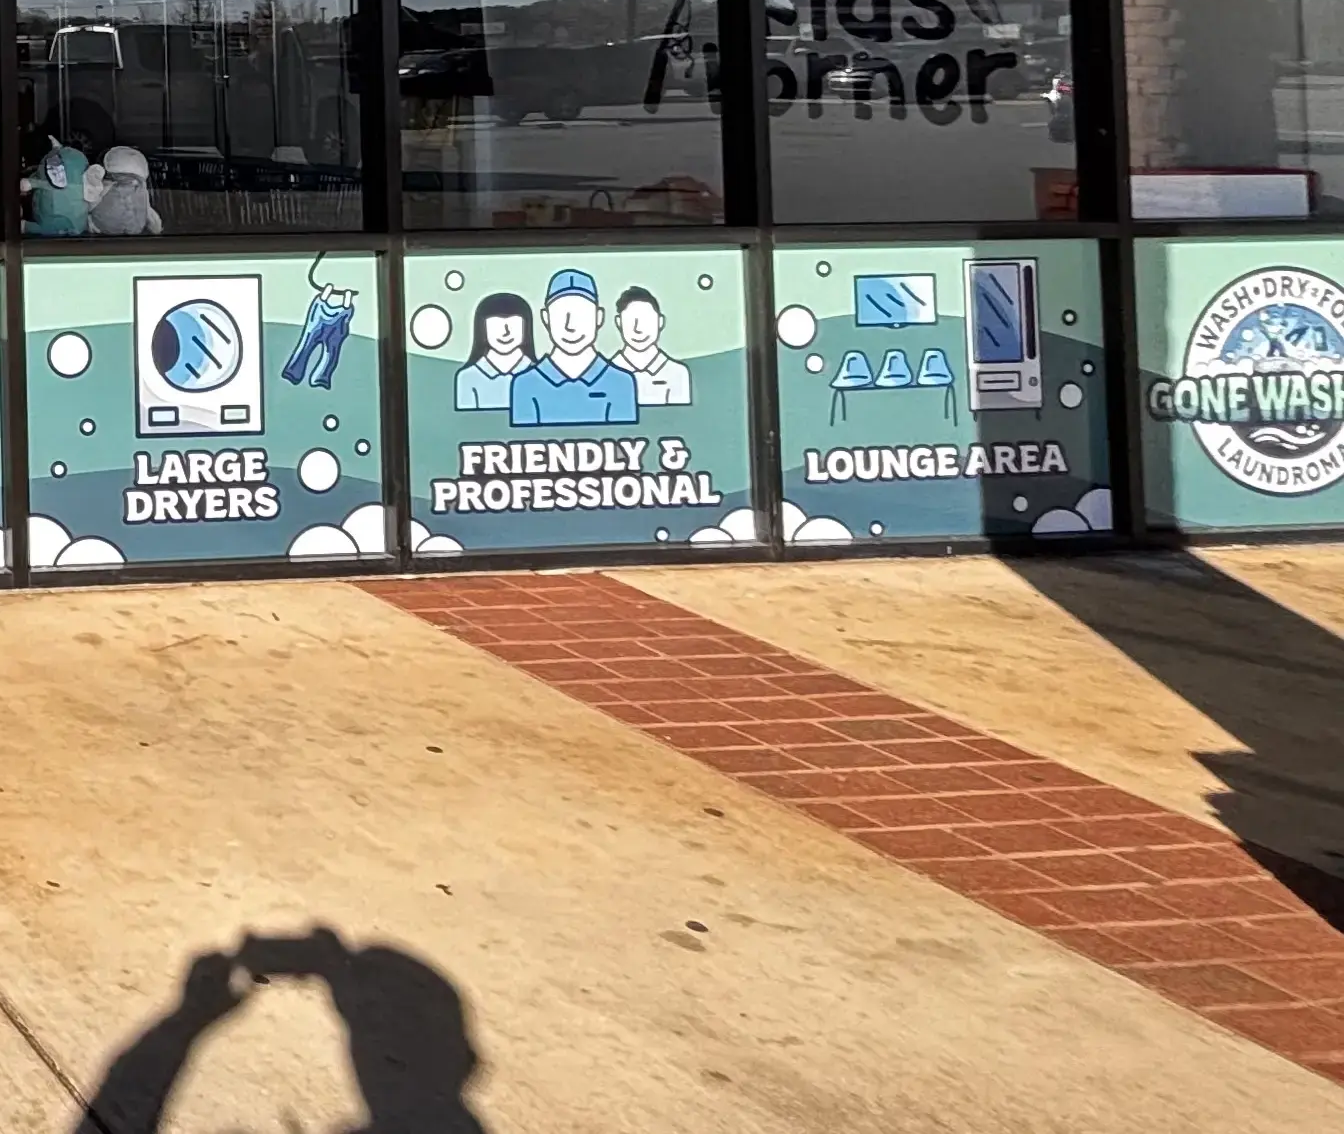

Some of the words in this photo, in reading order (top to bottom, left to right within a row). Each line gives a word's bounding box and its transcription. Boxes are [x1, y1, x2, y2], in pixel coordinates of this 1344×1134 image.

[703, 42, 1018, 126] orner
[1196, 285, 1255, 350] WASH
[1262, 275, 1310, 299] DRY
[1316, 288, 1344, 336] FO
[1150, 379, 1250, 422] GONE
[134, 450, 267, 486] LARGE
[461, 438, 648, 476] FRIENDLY
[659, 436, 692, 472] &
[806, 445, 960, 484] LOUNGE
[964, 442, 1068, 478] AREA
[125, 485, 281, 523] DRYERS
[432, 471, 723, 513] PROFESSIONAL
